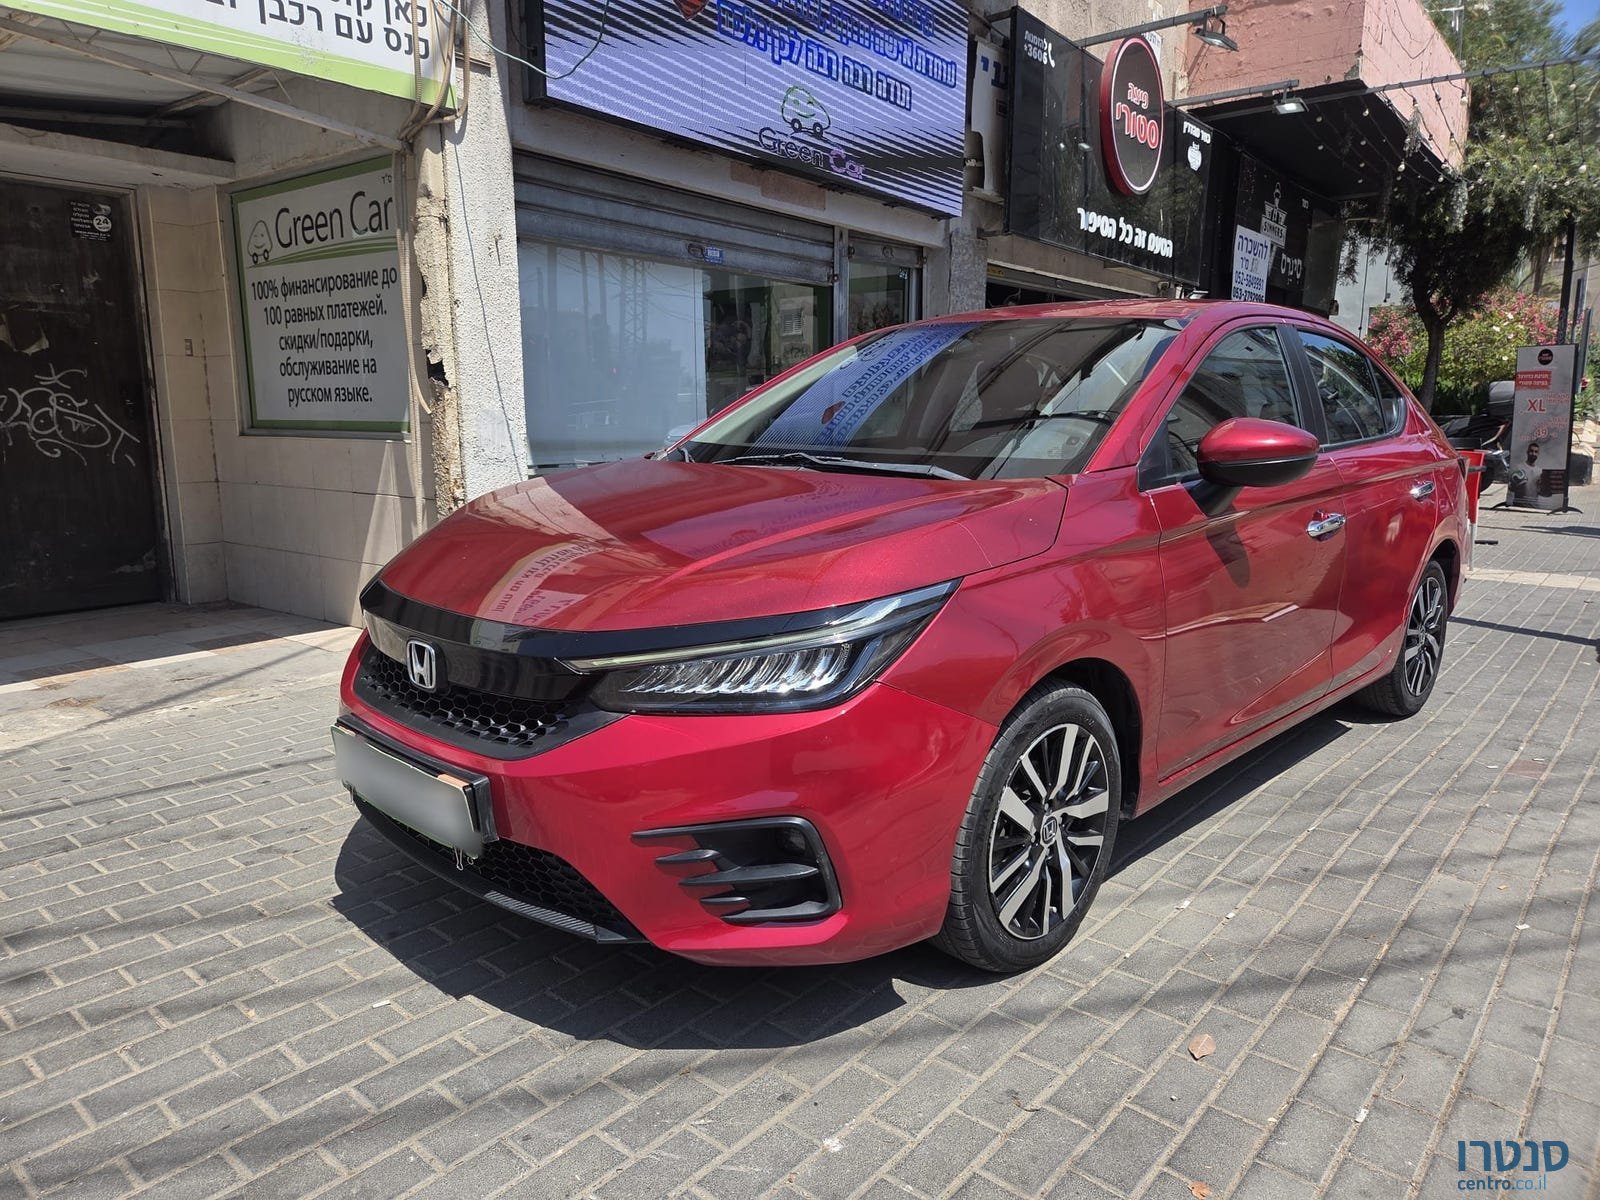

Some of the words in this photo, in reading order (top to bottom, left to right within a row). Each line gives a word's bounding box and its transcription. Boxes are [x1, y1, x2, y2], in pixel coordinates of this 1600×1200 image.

[334, 12, 373, 44] עם
[383, 26, 430, 60] כנס
[804, 38, 840, 82] רבה
[841, 55, 874, 96] רבה
[875, 70, 913, 111] תודה
[1127, 82, 1149, 109] פיצה
[1115, 102, 1159, 149] סטורי
[759, 126, 824, 168] Green
[275, 207, 345, 249] Green
[350, 190, 394, 236] Car
[1077, 207, 1118, 239] הסיפור
[1118, 216, 1134, 244] כל
[1133, 227, 1148, 249] זה
[1147, 232, 1174, 258] הטעם
[1237, 234, 1269, 260] להשכרה
[251, 278, 279, 301] 100%
[280, 269, 379, 302] финансирование
[381, 266, 398, 290] до
[264, 305, 282, 326] 100
[284, 304, 325, 328] равных
[327, 292, 388, 320] платежей.
[278, 327, 374, 354] скидки/подарки,
[279, 356, 360, 382] обслуживание
[362, 357, 378, 375] на
[287, 386, 332, 408] русском
[334, 384, 373, 403] языке.
[1527, 399, 1546, 412] XL
